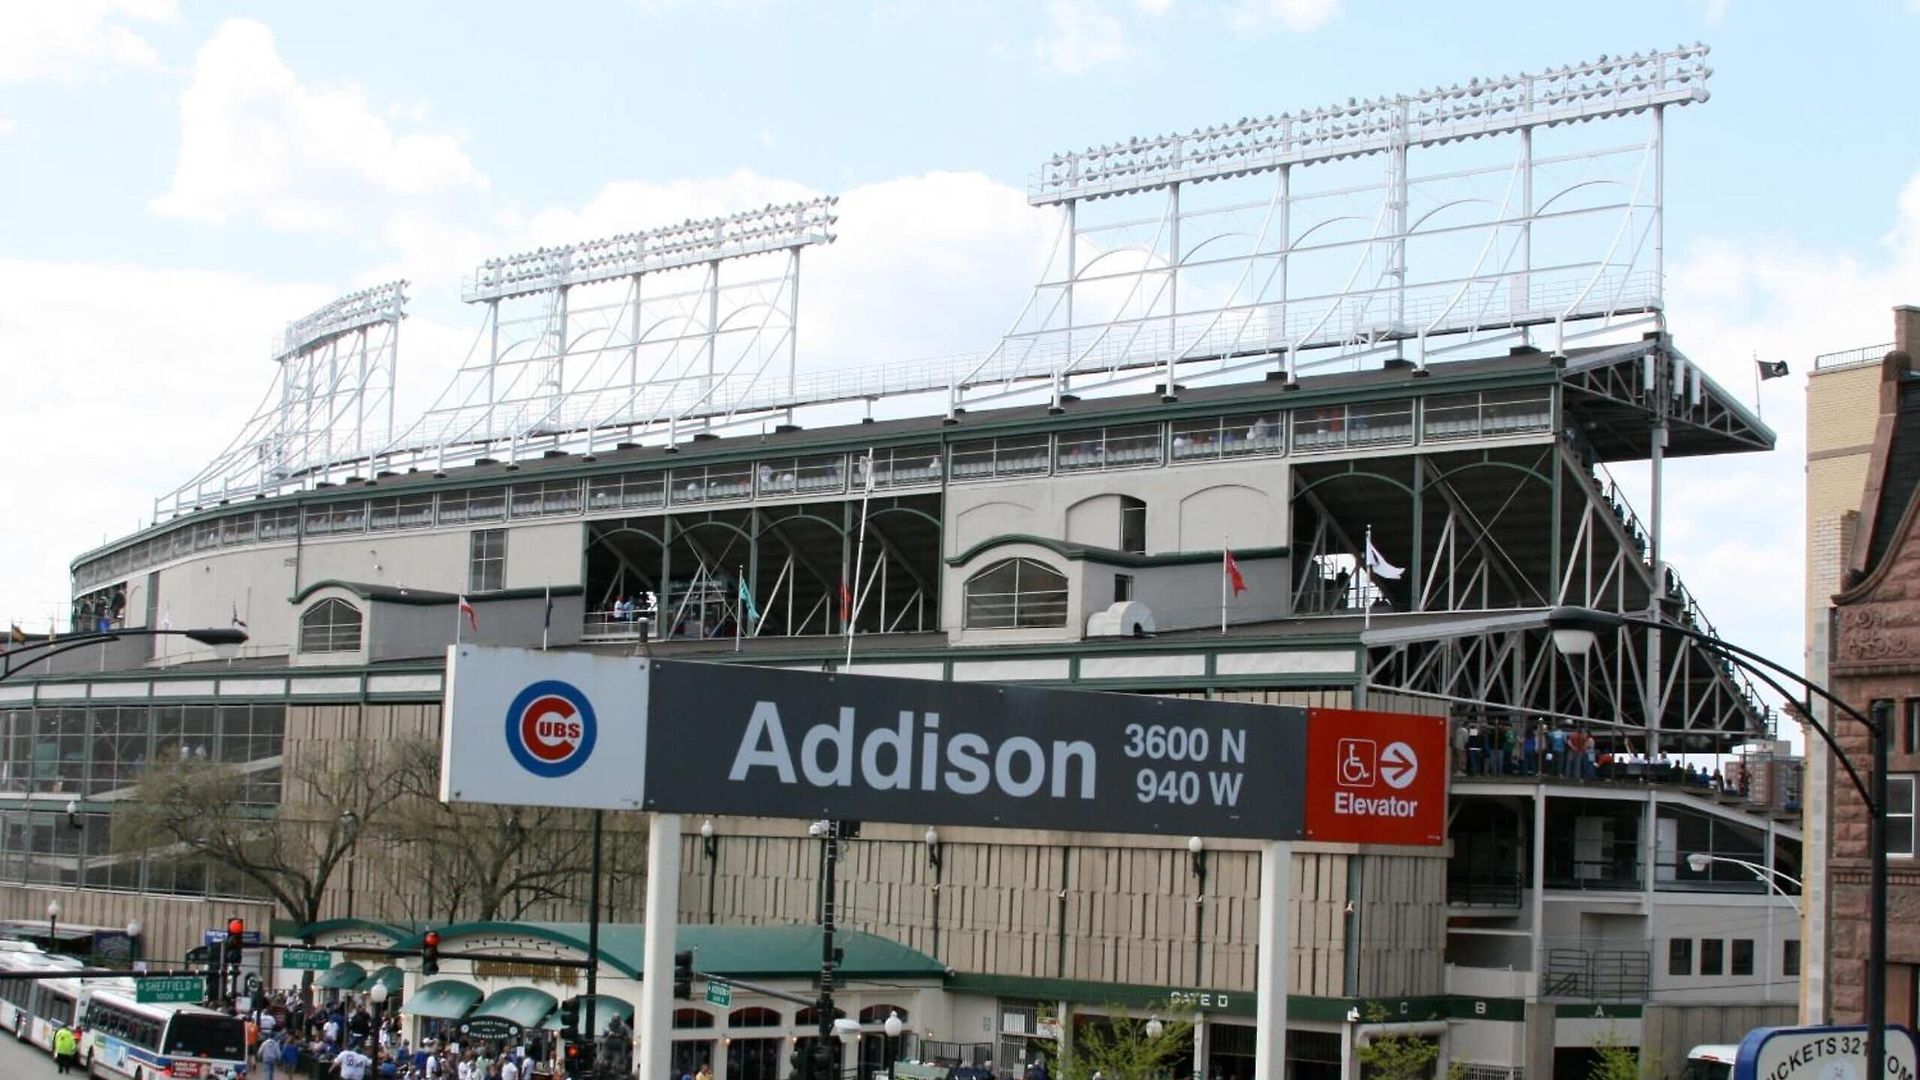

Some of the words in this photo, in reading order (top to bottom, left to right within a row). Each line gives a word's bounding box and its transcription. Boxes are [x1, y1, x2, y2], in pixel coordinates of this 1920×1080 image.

[522, 697, 580, 761] CUBS
[728, 700, 1097, 799] Addison
[1124, 723, 1209, 762] 3600
[1221, 728, 1246, 763] N
[1137, 768, 1200, 805] 940
[1208, 771, 1244, 806] W
[1335, 792, 1418, 817] Elevator
[145, 981, 192, 992] SHEFFIELD
[1218, 994, 1229, 1007] D
[1400, 1001, 1409, 1014] C
[1595, 1005, 1605, 1017] A
